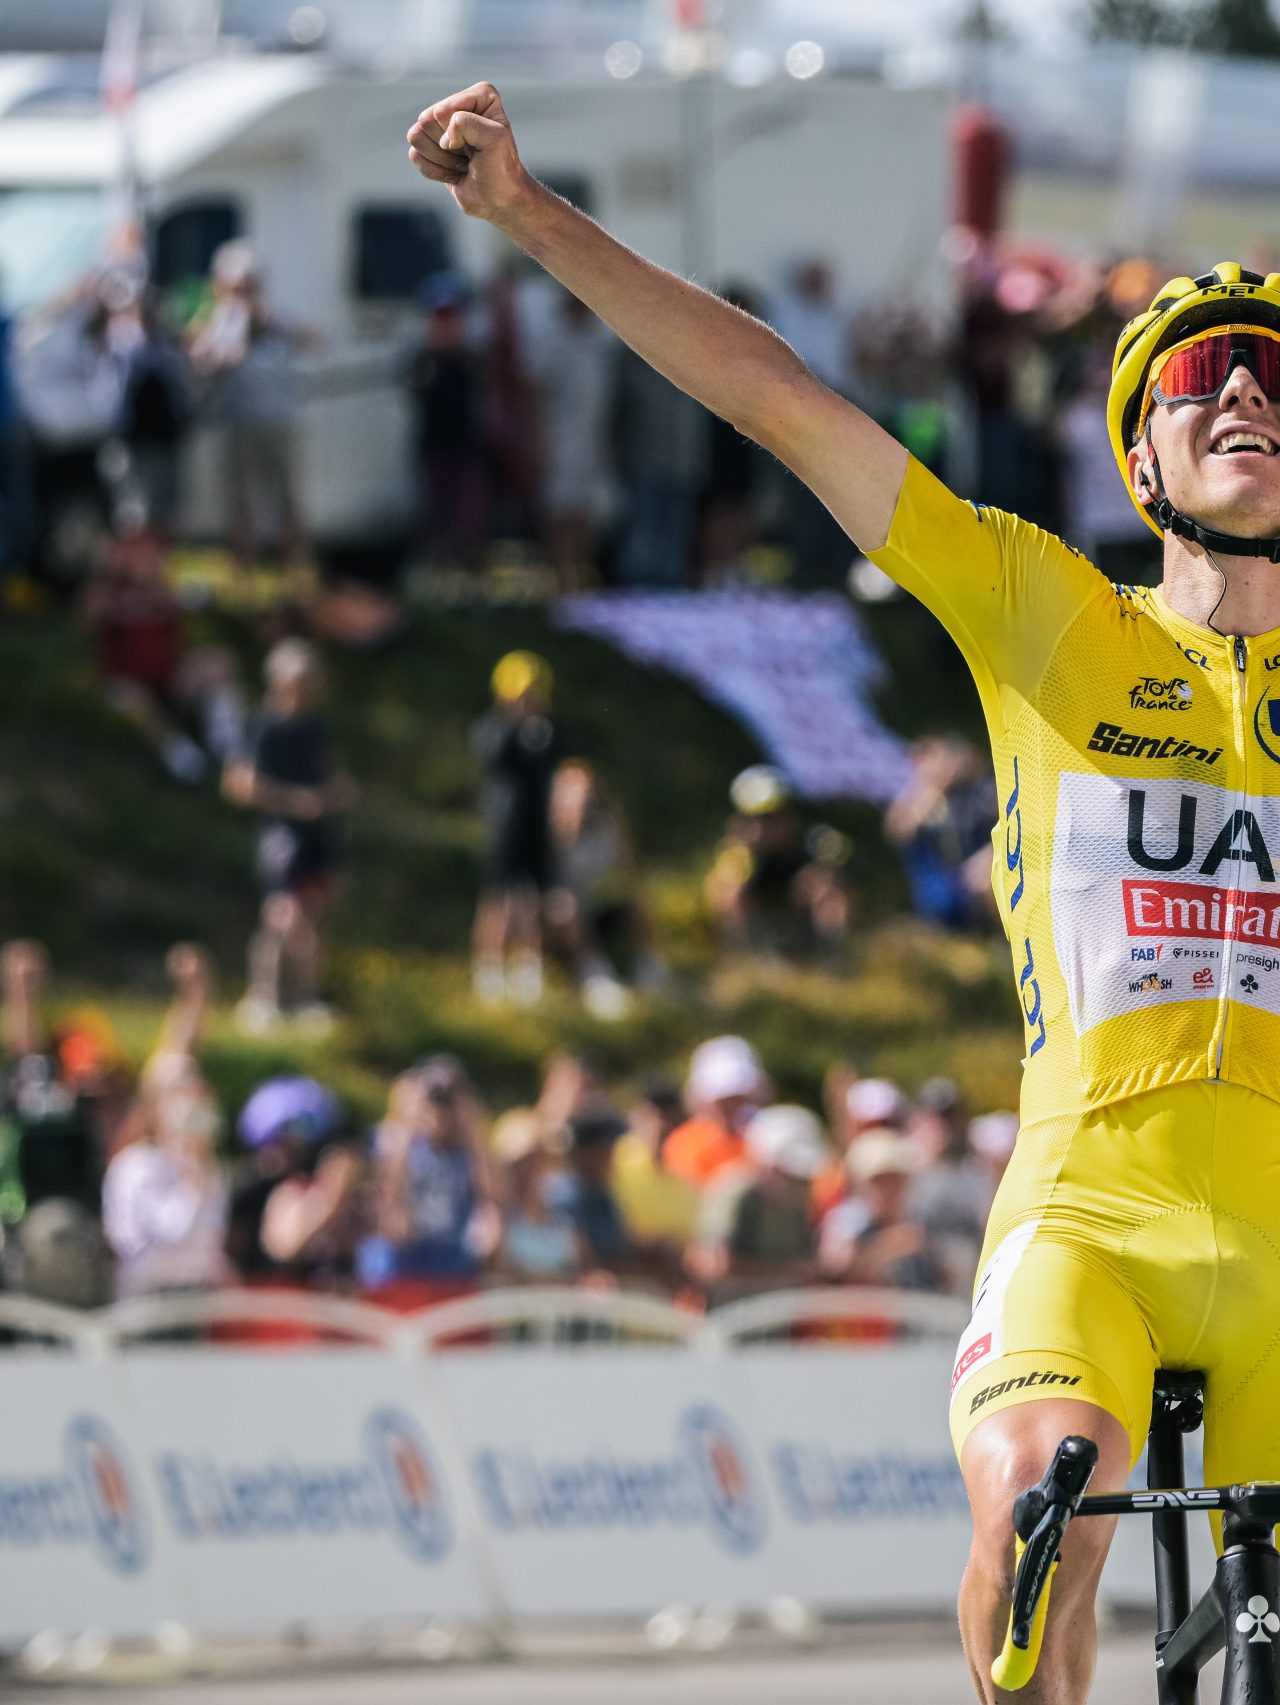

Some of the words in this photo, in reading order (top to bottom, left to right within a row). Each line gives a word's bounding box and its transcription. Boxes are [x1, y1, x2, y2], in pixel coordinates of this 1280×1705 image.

[1202, 286, 1260, 298] MET
[1087, 722, 1223, 765] Santini
[1184, 950, 1219, 958] PISSEI
[970, 1371, 1082, 1416] Santini
